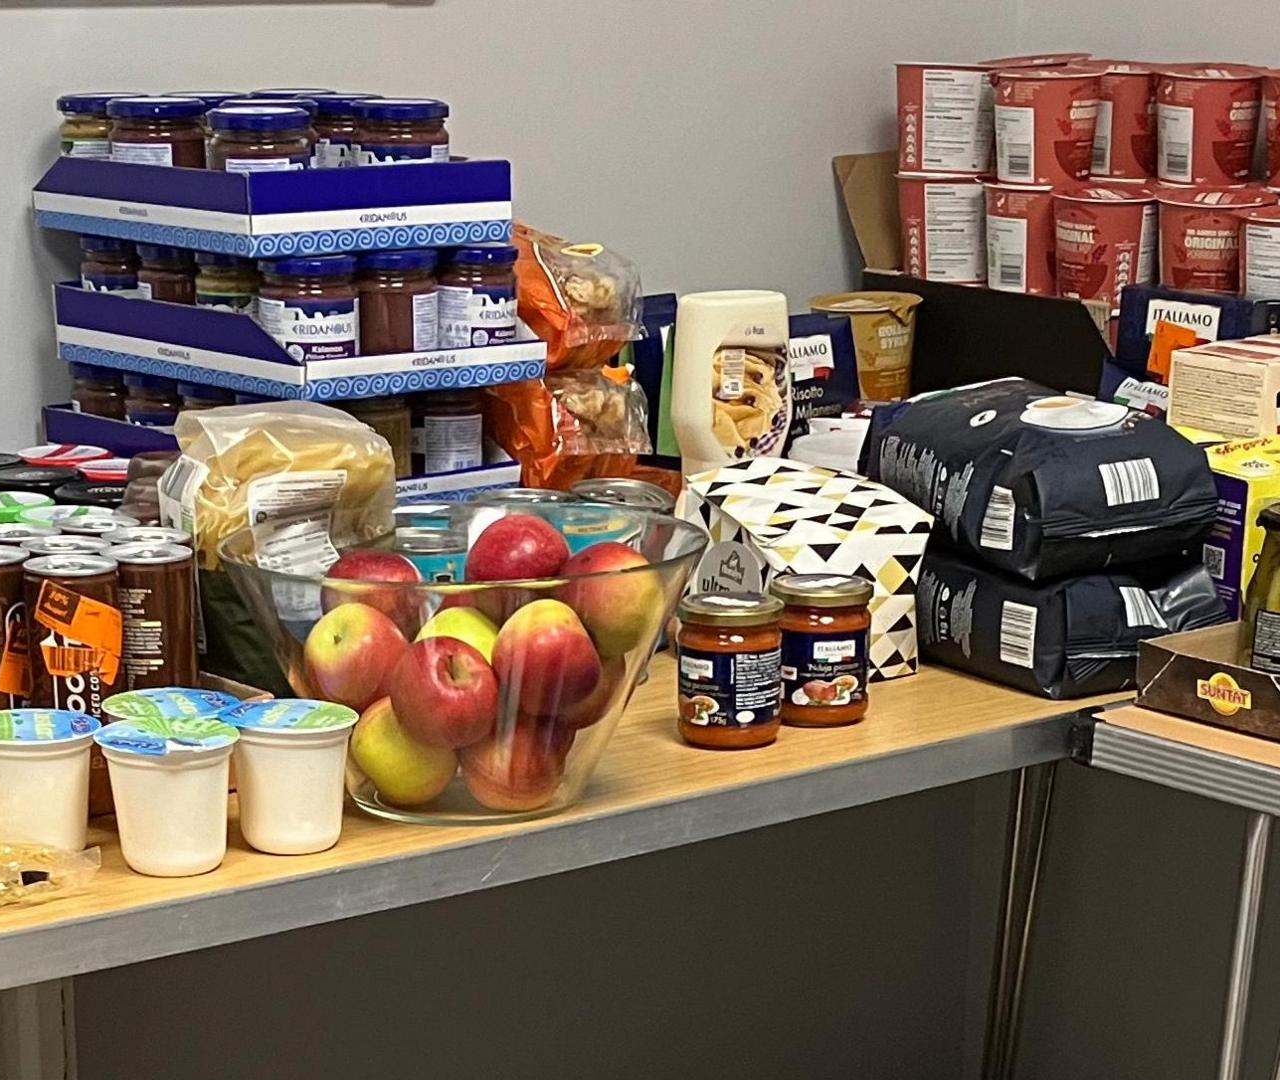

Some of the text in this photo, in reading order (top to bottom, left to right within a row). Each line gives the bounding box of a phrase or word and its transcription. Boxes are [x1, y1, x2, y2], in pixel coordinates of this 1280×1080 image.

[1153, 309, 1213, 328] ITALIAMO
[789, 343, 828, 361] ALIAMO
[1198, 681, 1249, 707] SUNTAT
